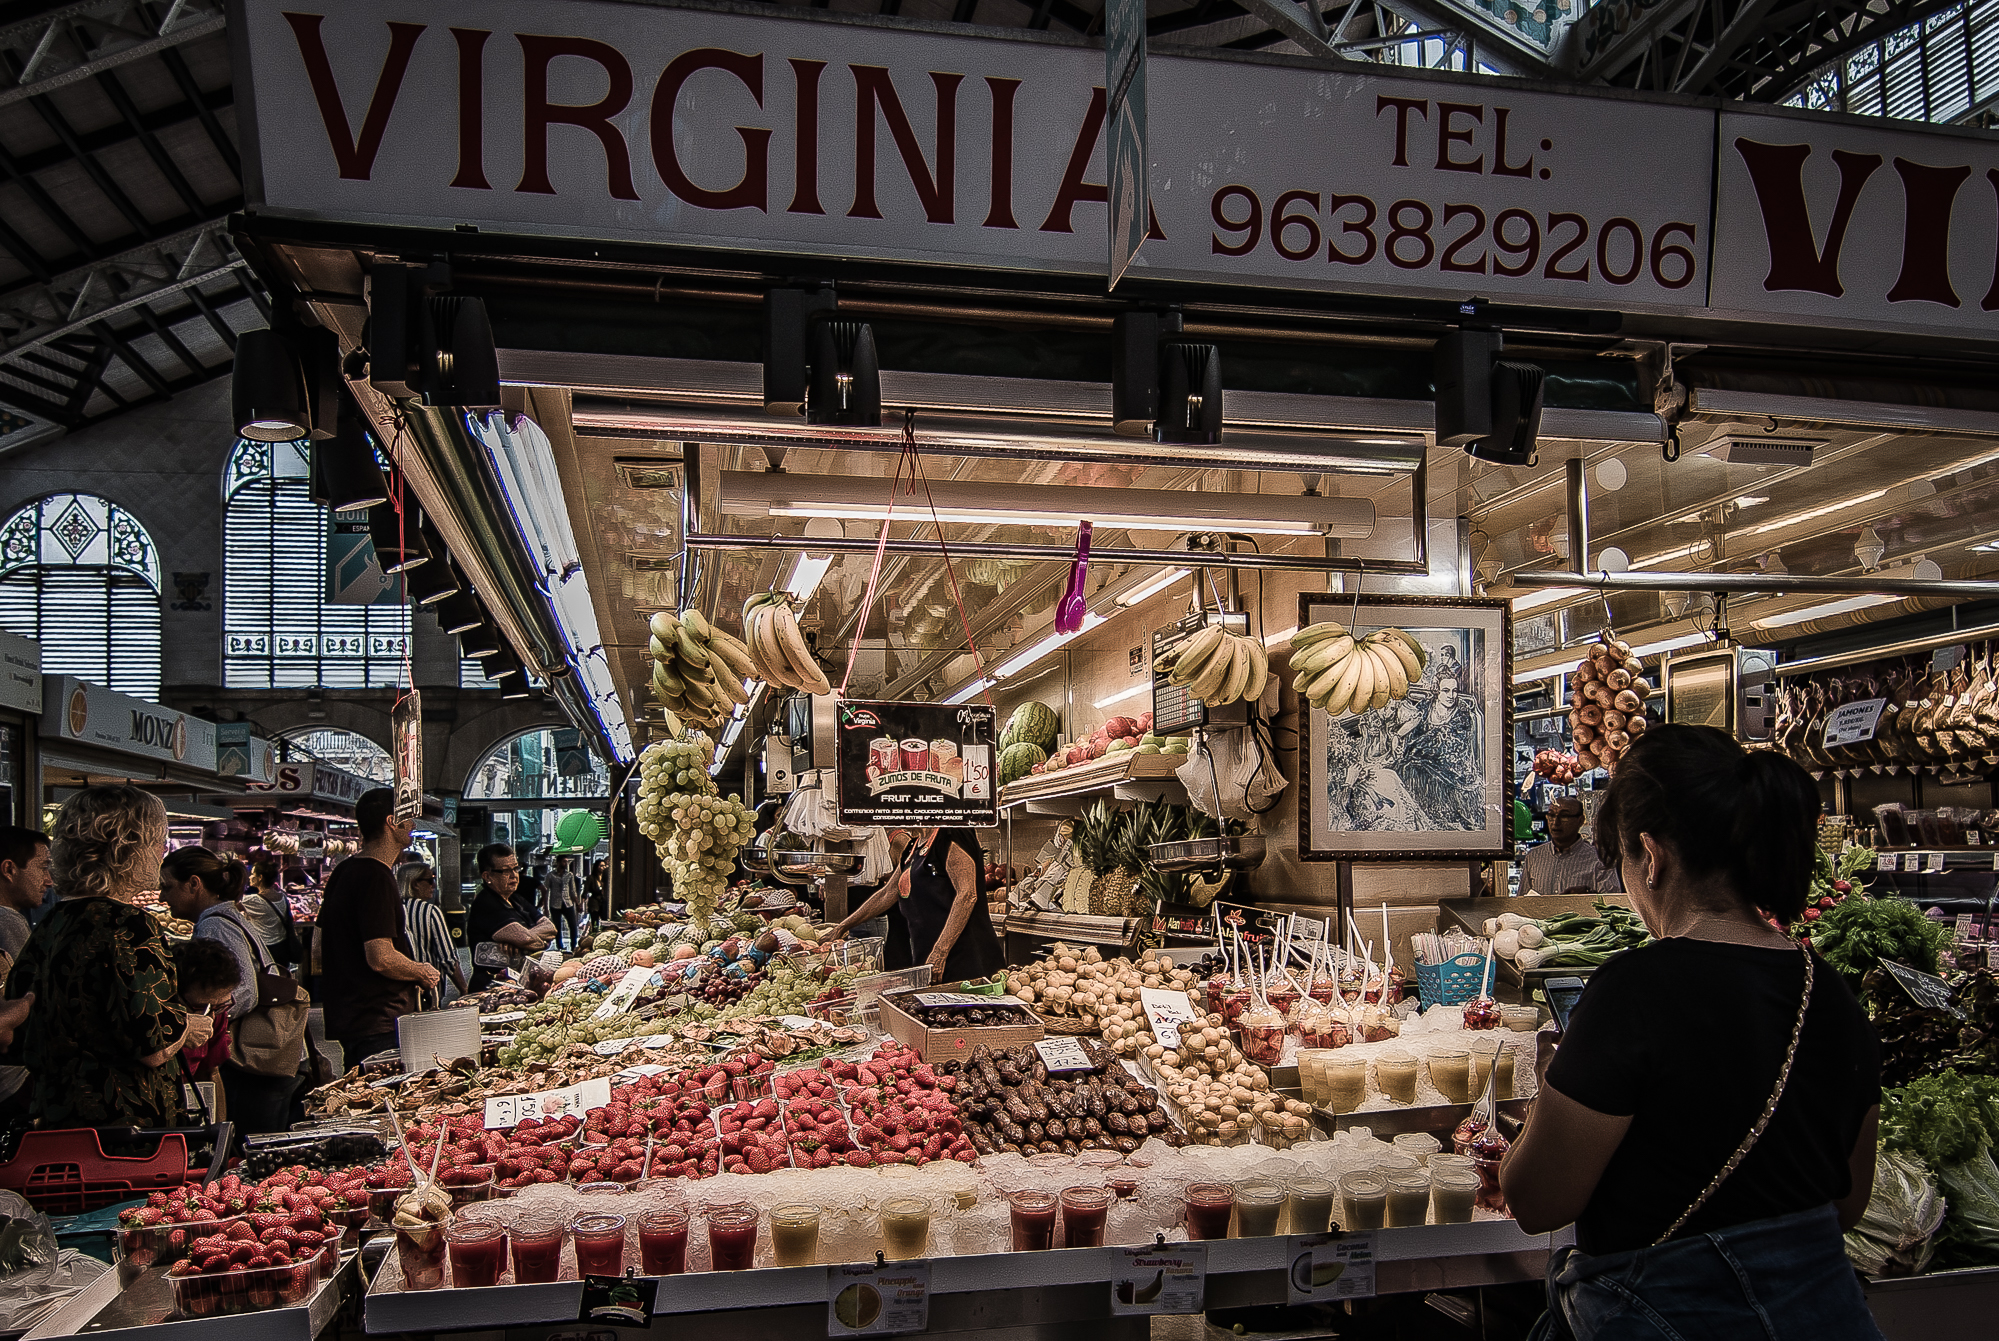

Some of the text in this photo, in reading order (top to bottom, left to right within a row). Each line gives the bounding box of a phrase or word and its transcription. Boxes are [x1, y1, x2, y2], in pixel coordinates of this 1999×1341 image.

[1376, 94, 1554, 181] TEL:
[1733, 136, 1999, 313] VI
[1211, 184, 1697, 290] 963829206
[1836, 705, 1875, 720] JAMONES
[853, 717, 876, 726] Virginia
[878, 772, 952, 788] ZUMOS DE FRUTA
[880, 795, 944, 803] FRUIT JUICE
[1336, 1242, 1369, 1252] Coconut
[1132, 1258, 1183, 1268] Strawberry
[842, 1267, 874, 1276] Virginia
[877, 1276, 917, 1287] Pineapple
[896, 1289, 925, 1297] Orange
